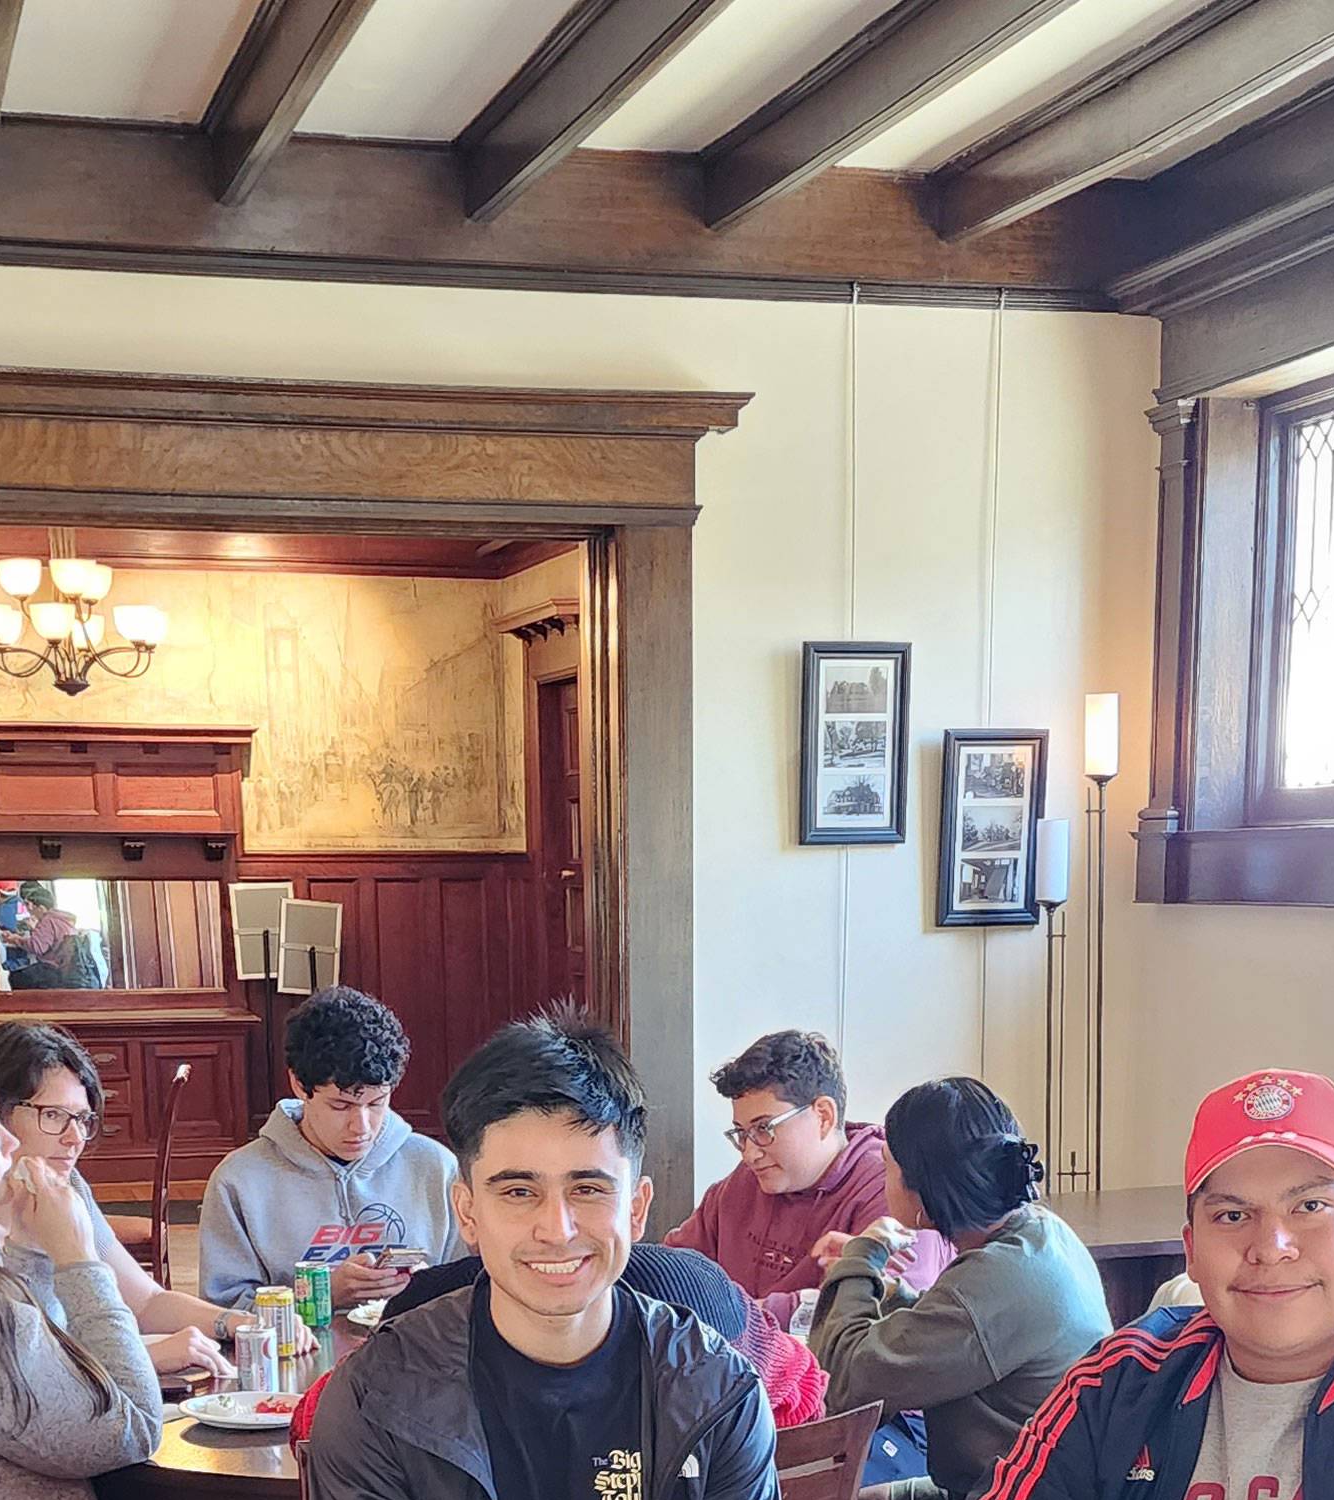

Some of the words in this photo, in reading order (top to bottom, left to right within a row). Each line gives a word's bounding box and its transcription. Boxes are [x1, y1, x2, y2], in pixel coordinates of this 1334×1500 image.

[310, 1223, 386, 1245] BIG
[592, 1456, 608, 1467] The
[608, 1449, 641, 1472] Big
